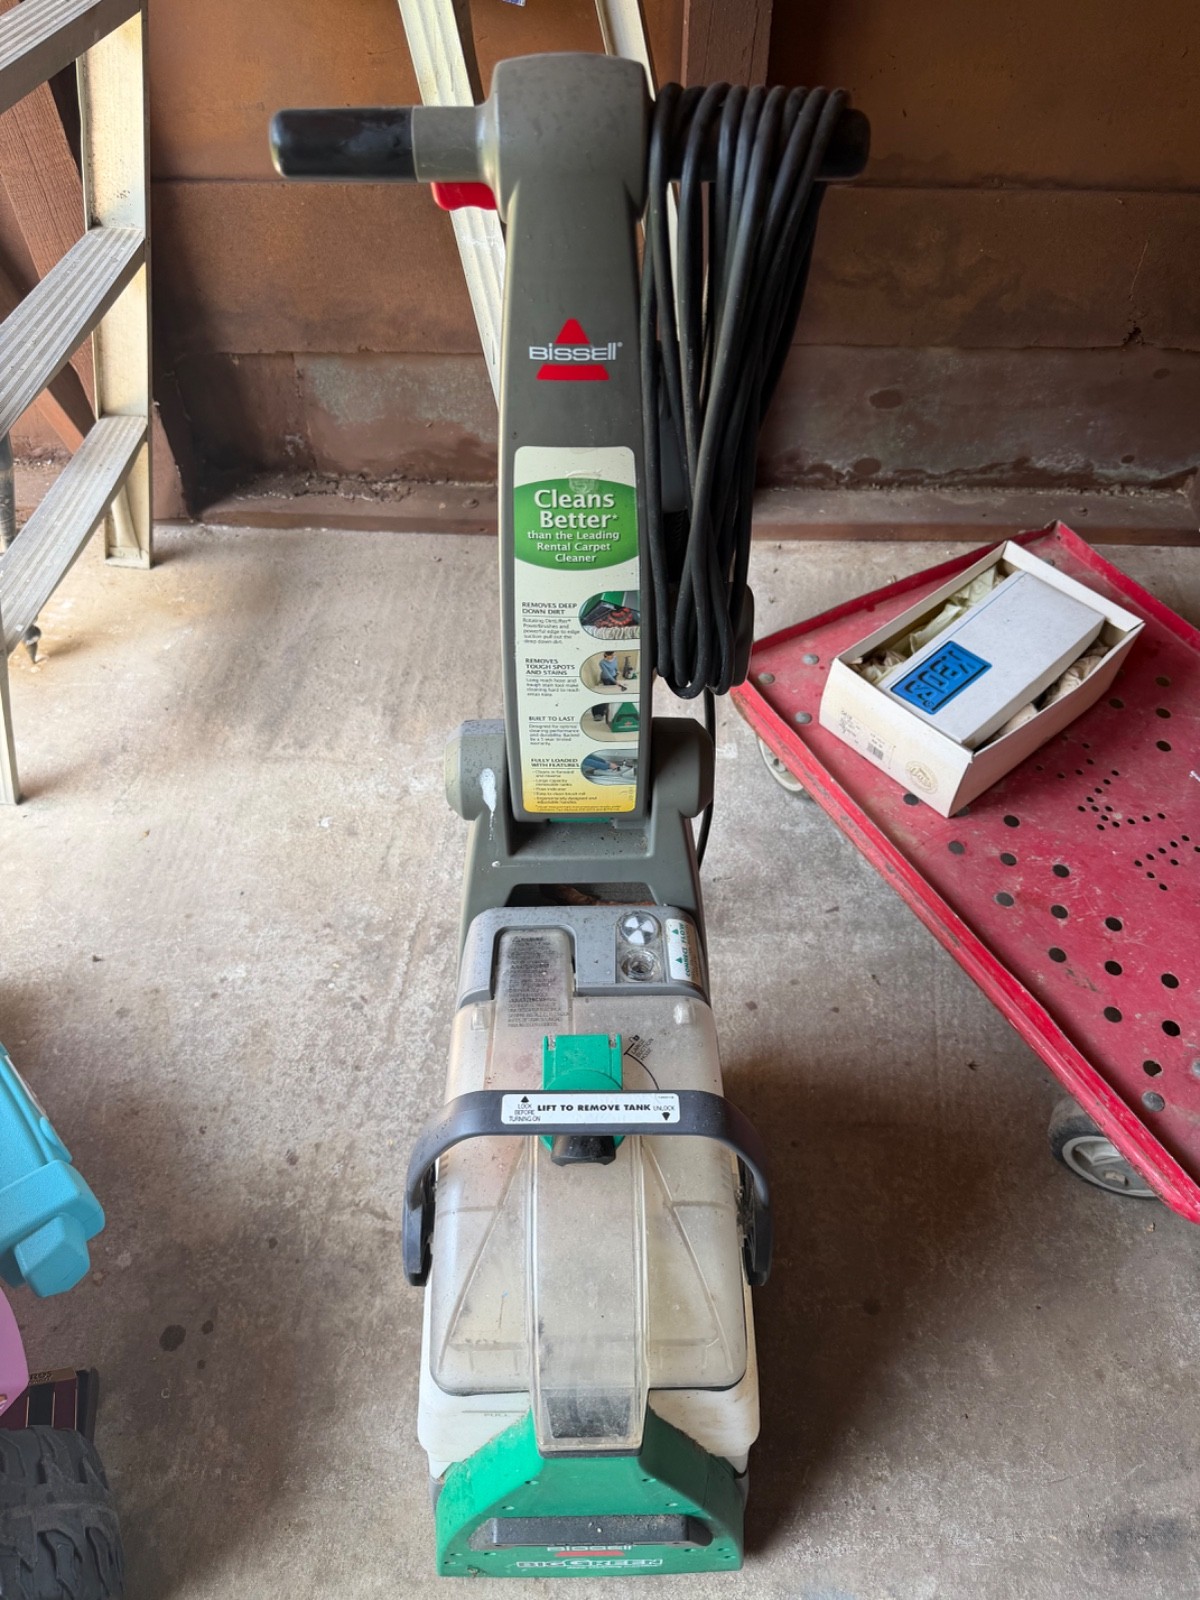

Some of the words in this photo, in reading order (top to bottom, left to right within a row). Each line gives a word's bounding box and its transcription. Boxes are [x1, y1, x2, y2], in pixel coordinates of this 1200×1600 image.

[534, 489, 615, 509] Cleans
[528, 531, 552, 541] than
[556, 531, 573, 540] the
[576, 531, 620, 542] Leading
[537, 543, 571, 551] Rental
[574, 543, 611, 553] Carpet
[555, 554, 597, 563] Cleaner
[679, 922, 687, 944] FLOW
[682, 946, 690, 977] CONNECT
